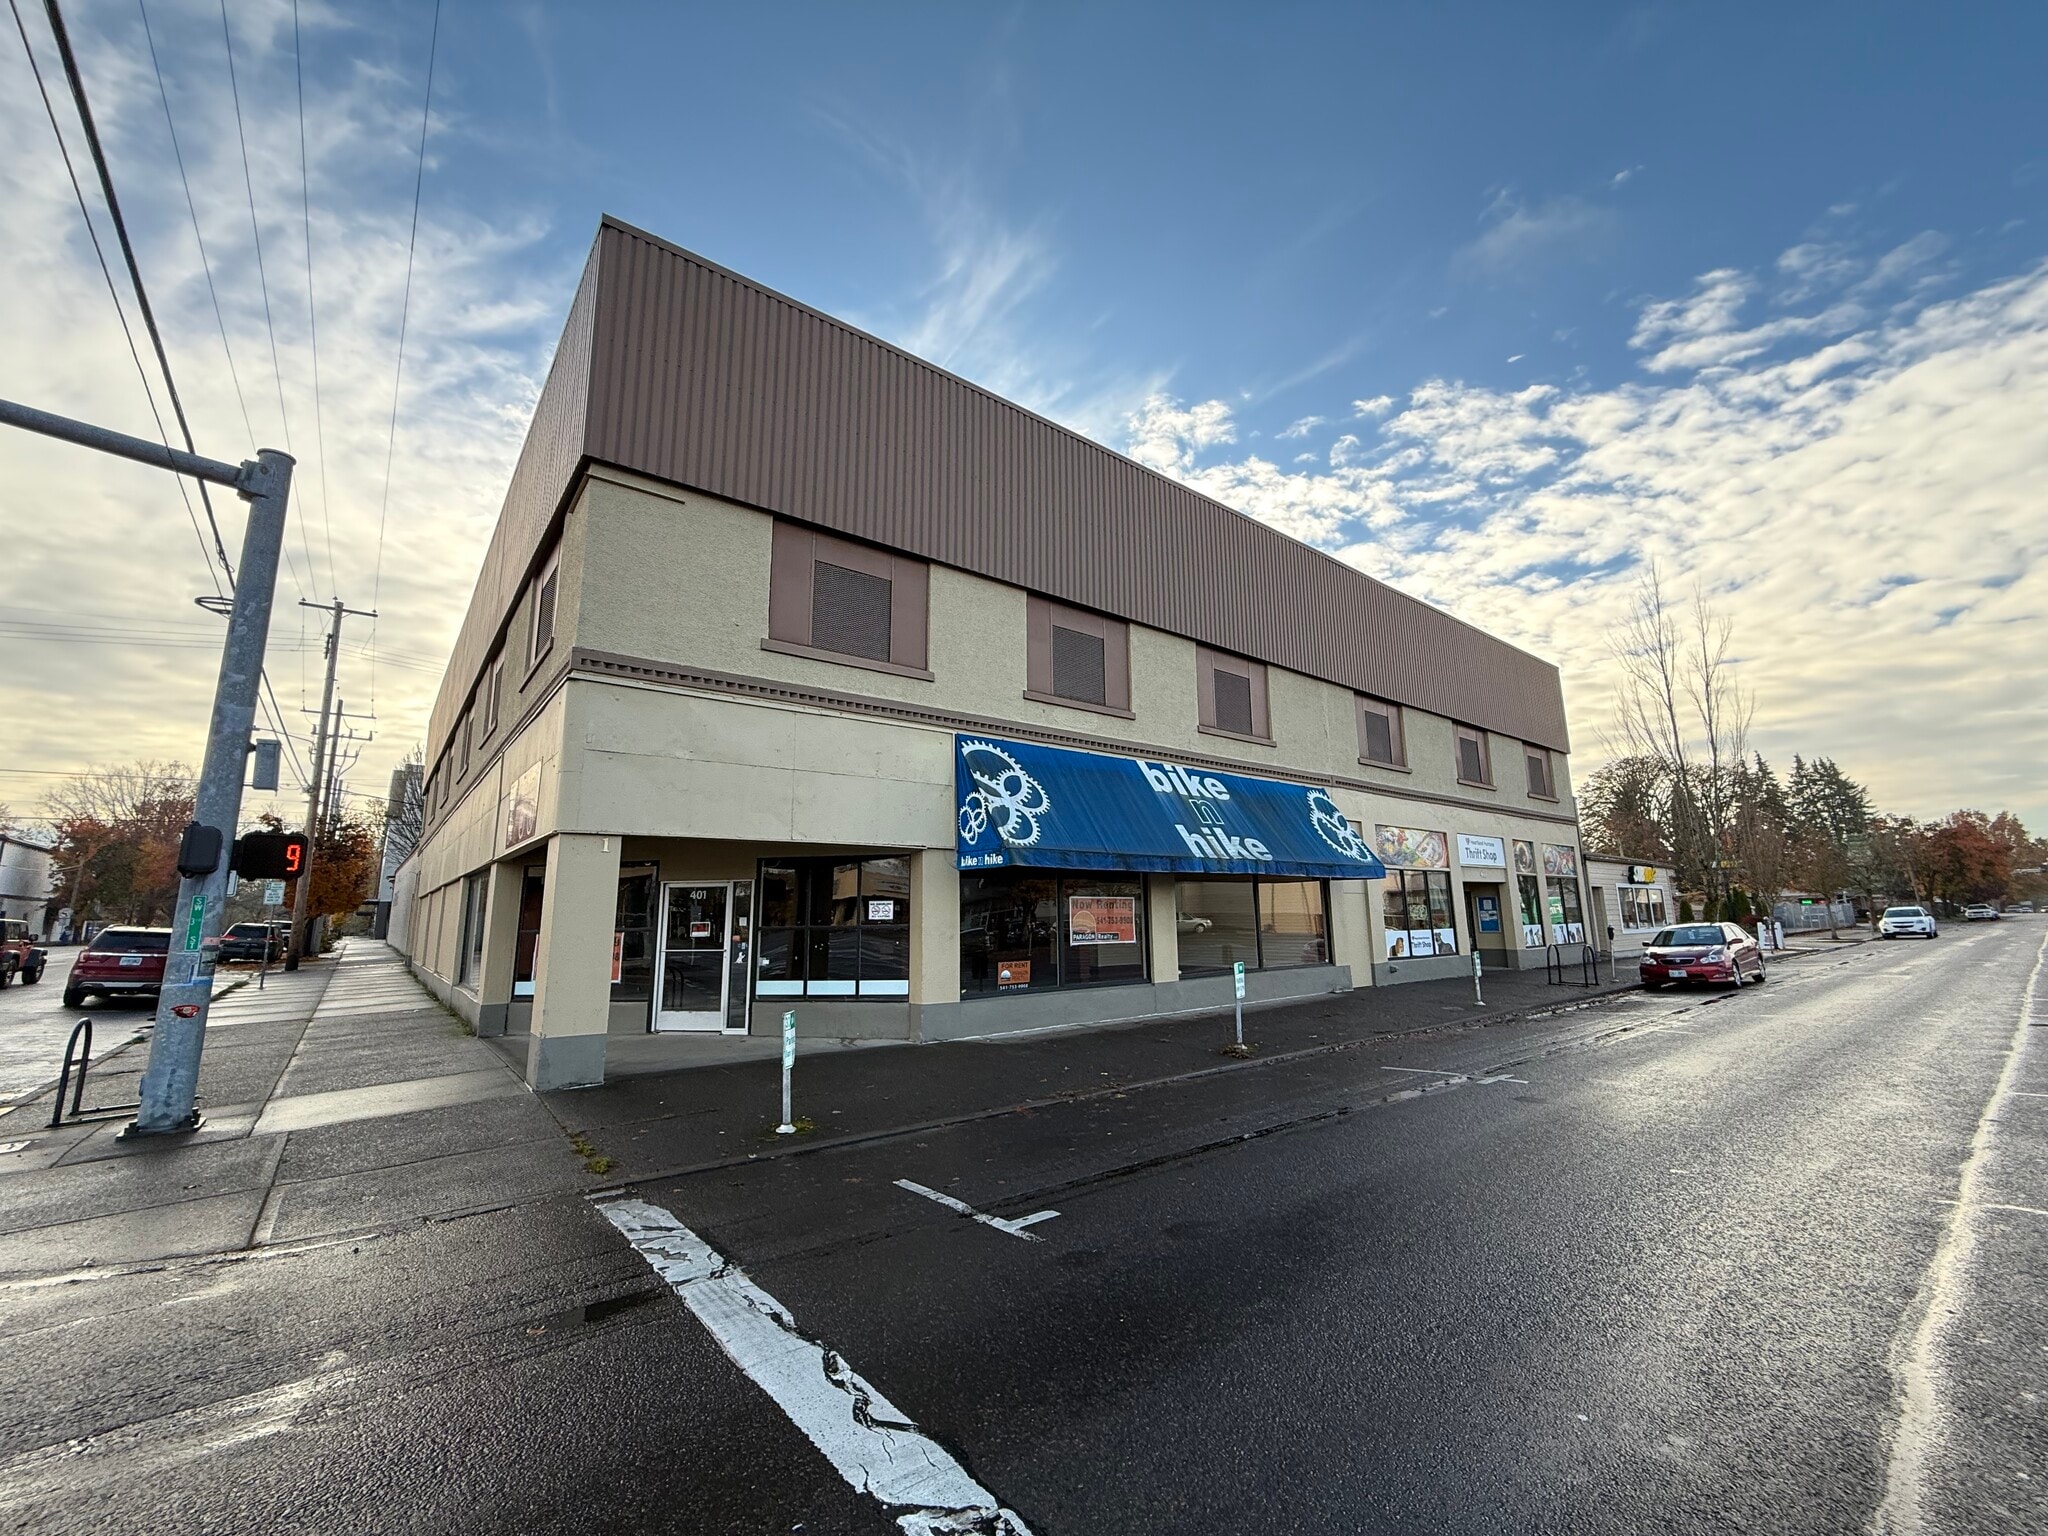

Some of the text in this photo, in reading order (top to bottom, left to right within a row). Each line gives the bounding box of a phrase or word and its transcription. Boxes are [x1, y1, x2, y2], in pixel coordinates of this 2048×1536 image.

[1136, 760, 1230, 800] bike
[1189, 799, 1224, 825] n
[602, 837, 609, 852] 1
[1174, 824, 1273, 861] hike
[286, 844, 301, 871] 9
[961, 855, 977, 867] bike
[984, 853, 1004, 865] hike
[1464, 847, 1497, 864] Thrift Shop
[690, 890, 707, 900] 401
[194, 897, 203, 911] SW
[1072, 899, 1133, 912] Now Renting
[190, 935, 197, 949] ST
